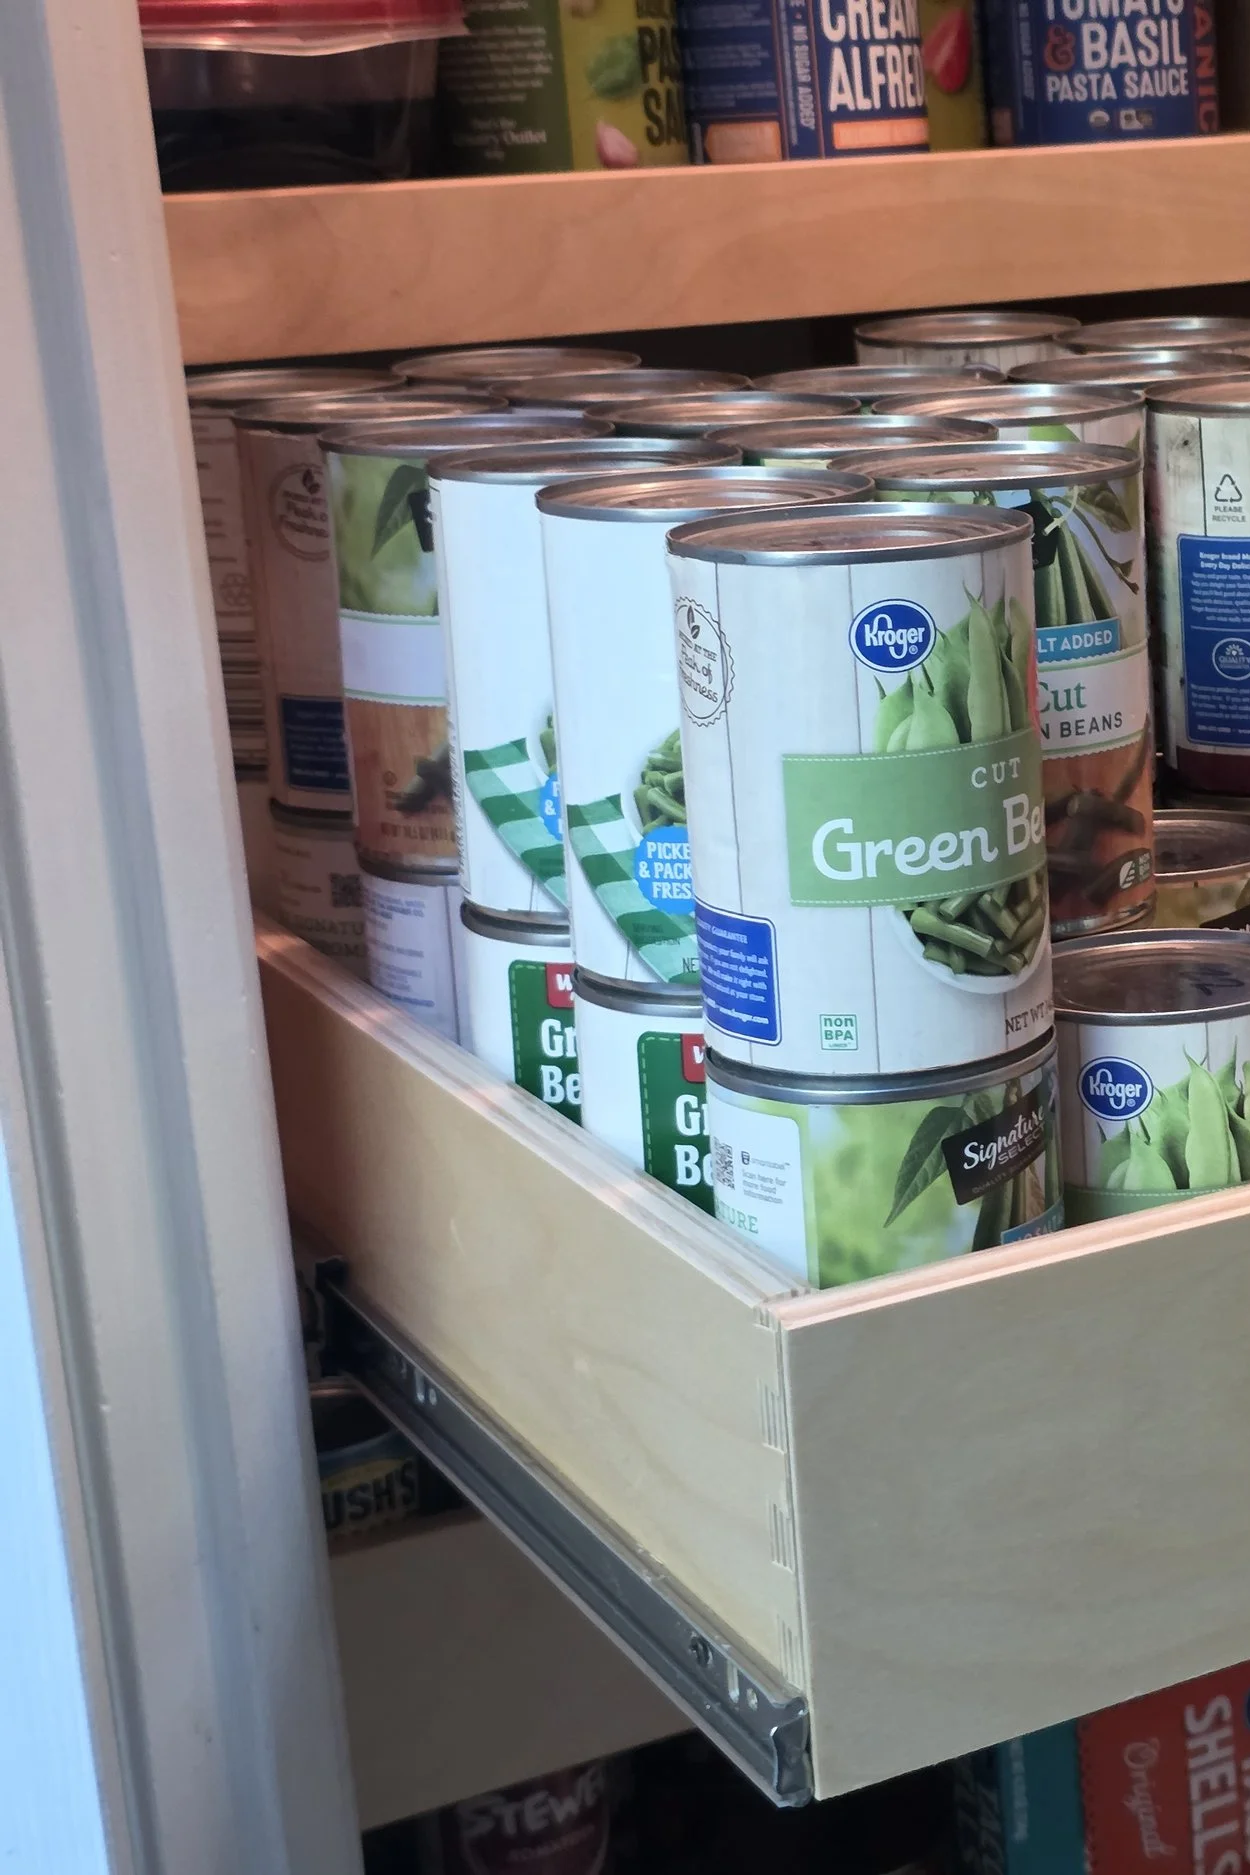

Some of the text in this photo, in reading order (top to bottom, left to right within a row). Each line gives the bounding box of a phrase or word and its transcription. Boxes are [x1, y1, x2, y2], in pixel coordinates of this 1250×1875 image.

[1043, 23, 1076, 72] &
[1081, 17, 1188, 70] BASIL
[1046, 68, 1190, 103] PASTA SAUCE
[1211, 514, 1247, 524] RECYCLE
[1214, 505, 1243, 514] PLEASE
[864, 613, 926, 660] Kroger
[1060, 629, 1113, 651] ADDED
[1218, 655, 1250, 664] QUALITY
[1038, 681, 1088, 713] Cut
[1059, 711, 1124, 739] BEANS
[970, 756, 1021, 789] CUT
[811, 792, 1046, 882] Green Be
[638, 862, 692, 880] & PACK
[652, 881, 692, 900] FRES
[711, 926, 748, 945] GUARANTEE
[822, 1015, 854, 1028] non
[1004, 1010, 1030, 1036] NET
[823, 1029, 855, 1042] BPA
[1088, 1068, 1143, 1110] Kroger
[963, 1104, 1045, 1170] Signature
[997, 1121, 1046, 1165] SELECT
[742, 1179, 777, 1195] more food
[757, 1172, 774, 1184] here
[775, 1176, 787, 1187] for
[743, 1189, 784, 1205] information
[1184, 1693, 1242, 1875] SHELLS
[1123, 1737, 1178, 1860] Original
